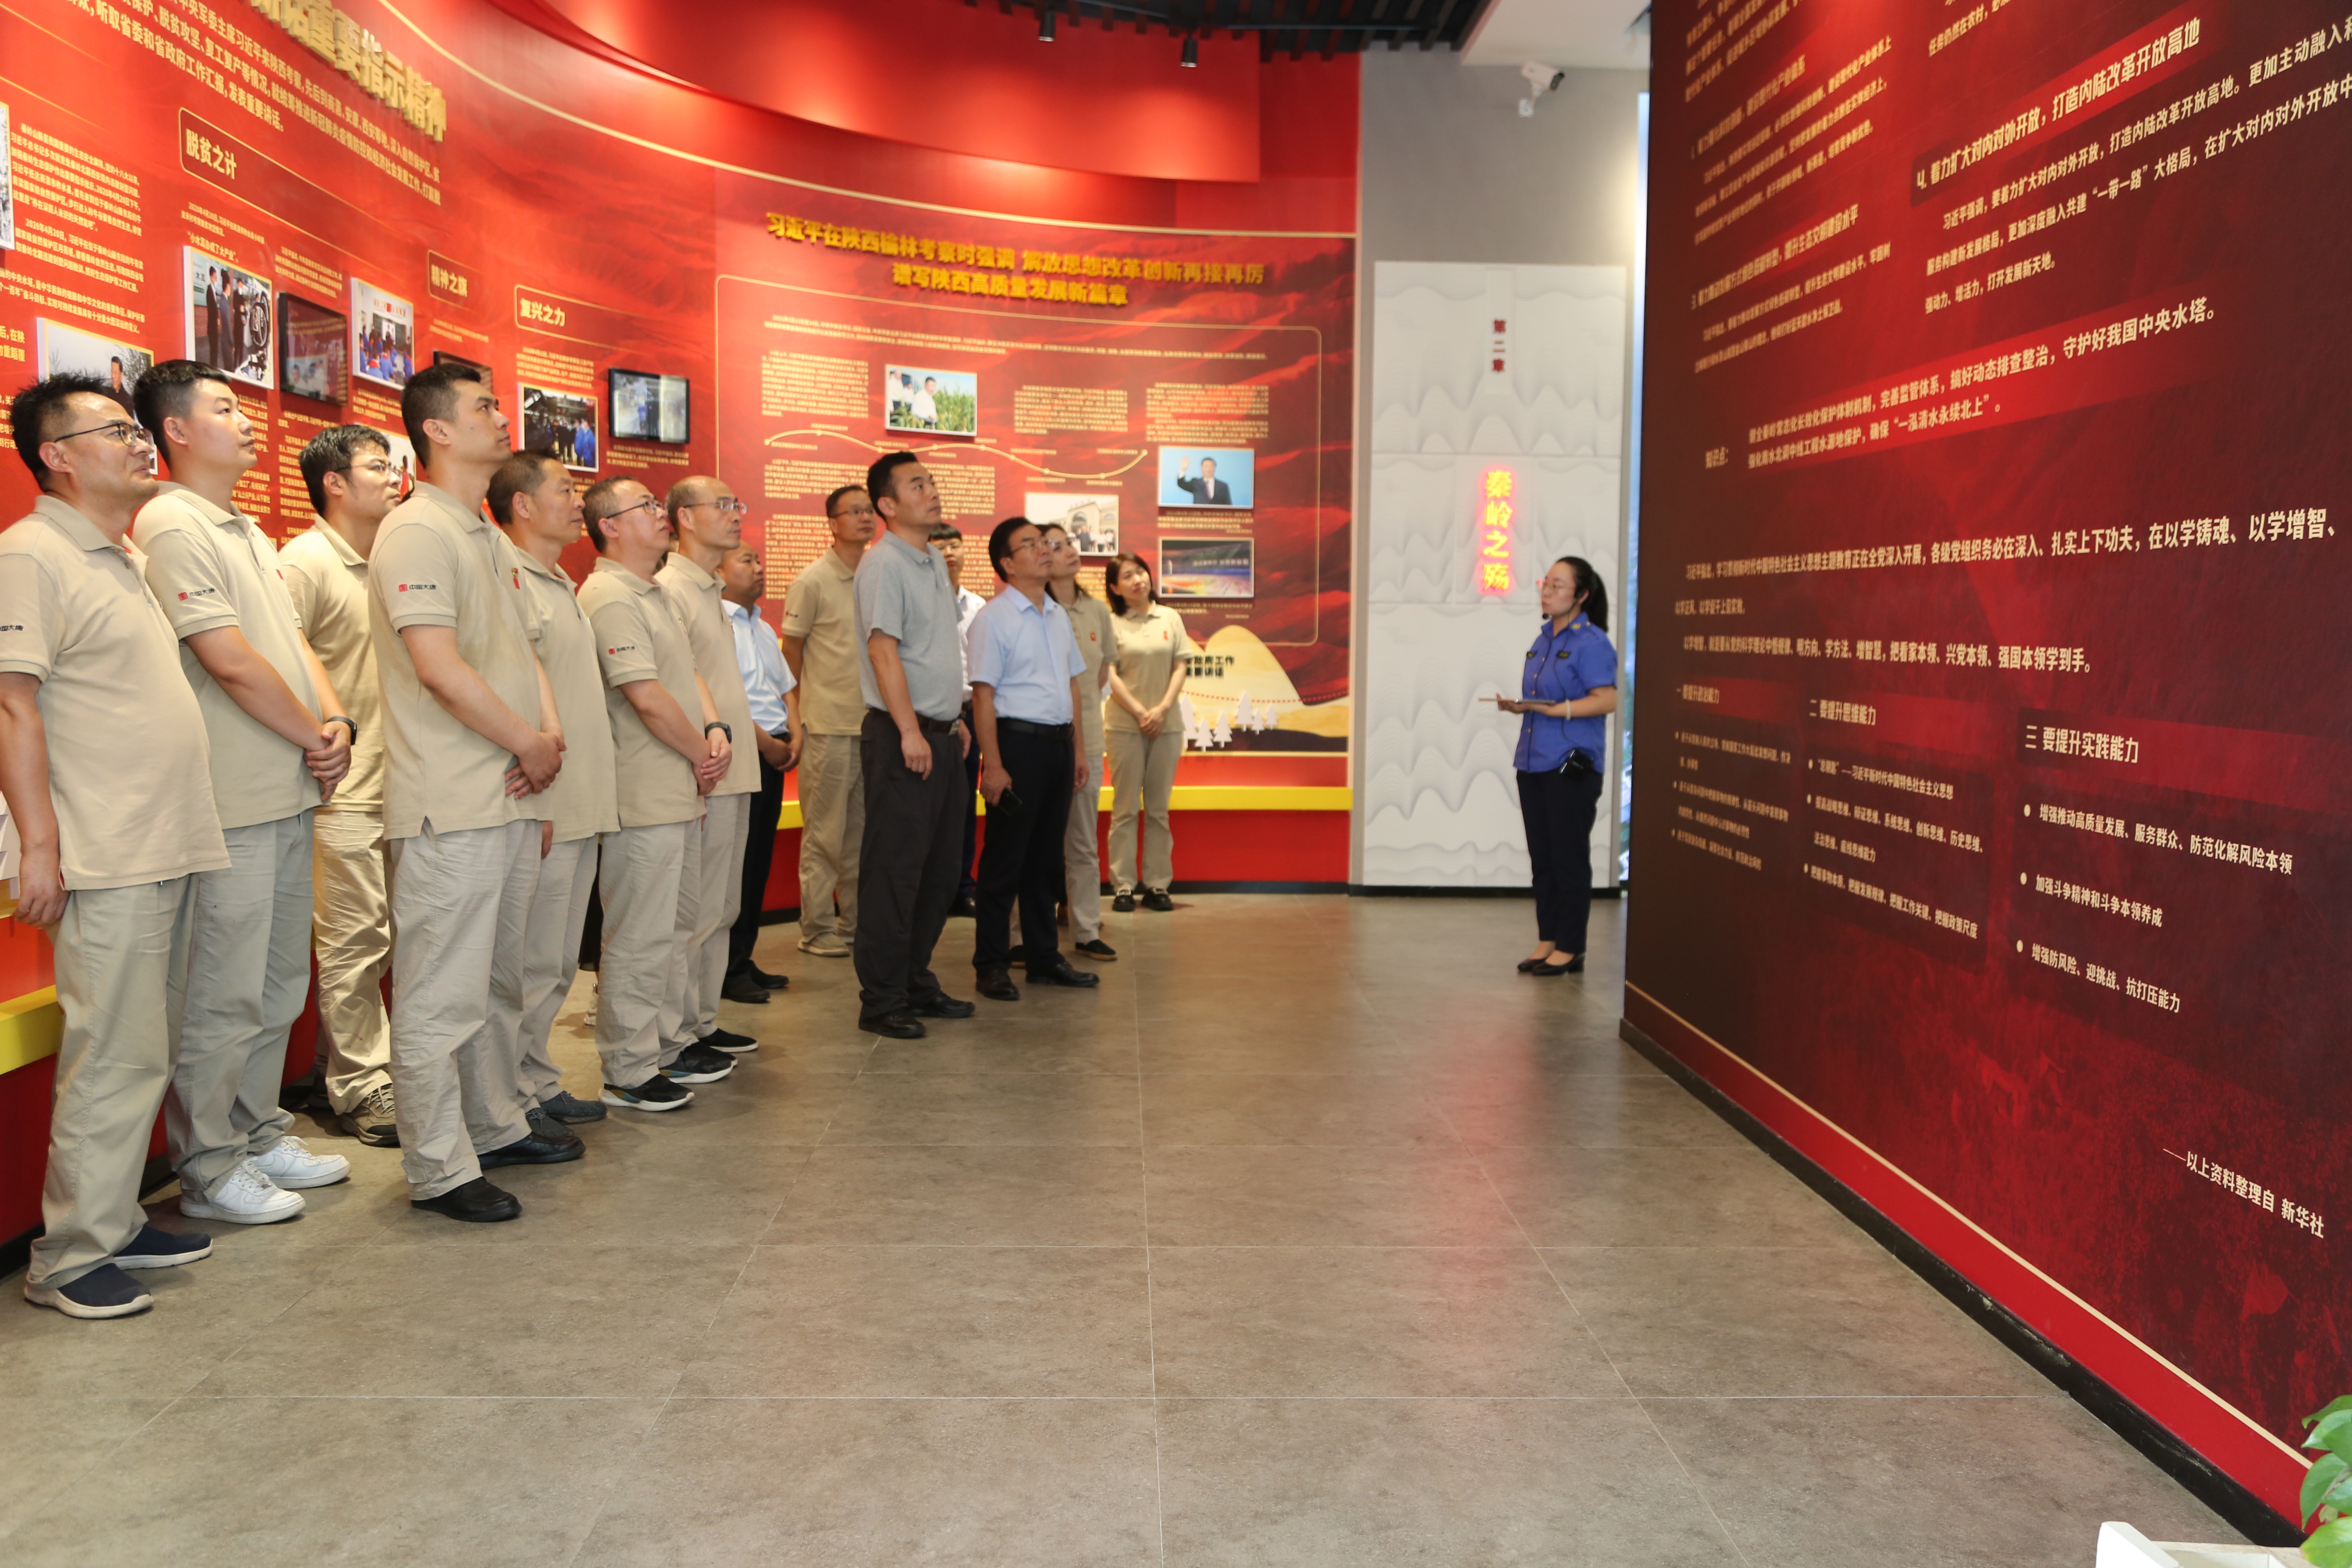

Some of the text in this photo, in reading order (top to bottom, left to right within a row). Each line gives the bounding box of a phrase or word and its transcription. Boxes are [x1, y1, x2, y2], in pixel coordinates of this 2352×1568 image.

[186, 129, 237, 179] 脱贫之计
[767, 212, 1265, 285] 习近平在陕西榆林考察时强调 解放思想改革创新再接再厉
[431, 264, 468, 297] 精神之旗
[520, 297, 566, 327] 复兴之力
[189, 588, 215, 597] 中国大唐
[2036, 874, 2163, 928] 加强斗争精神和斗争本领养成
[2032, 942, 2180, 1013] 增强防风险、迎挑战、抗打压能力
[2281, 1198, 2324, 1239] 新华社
